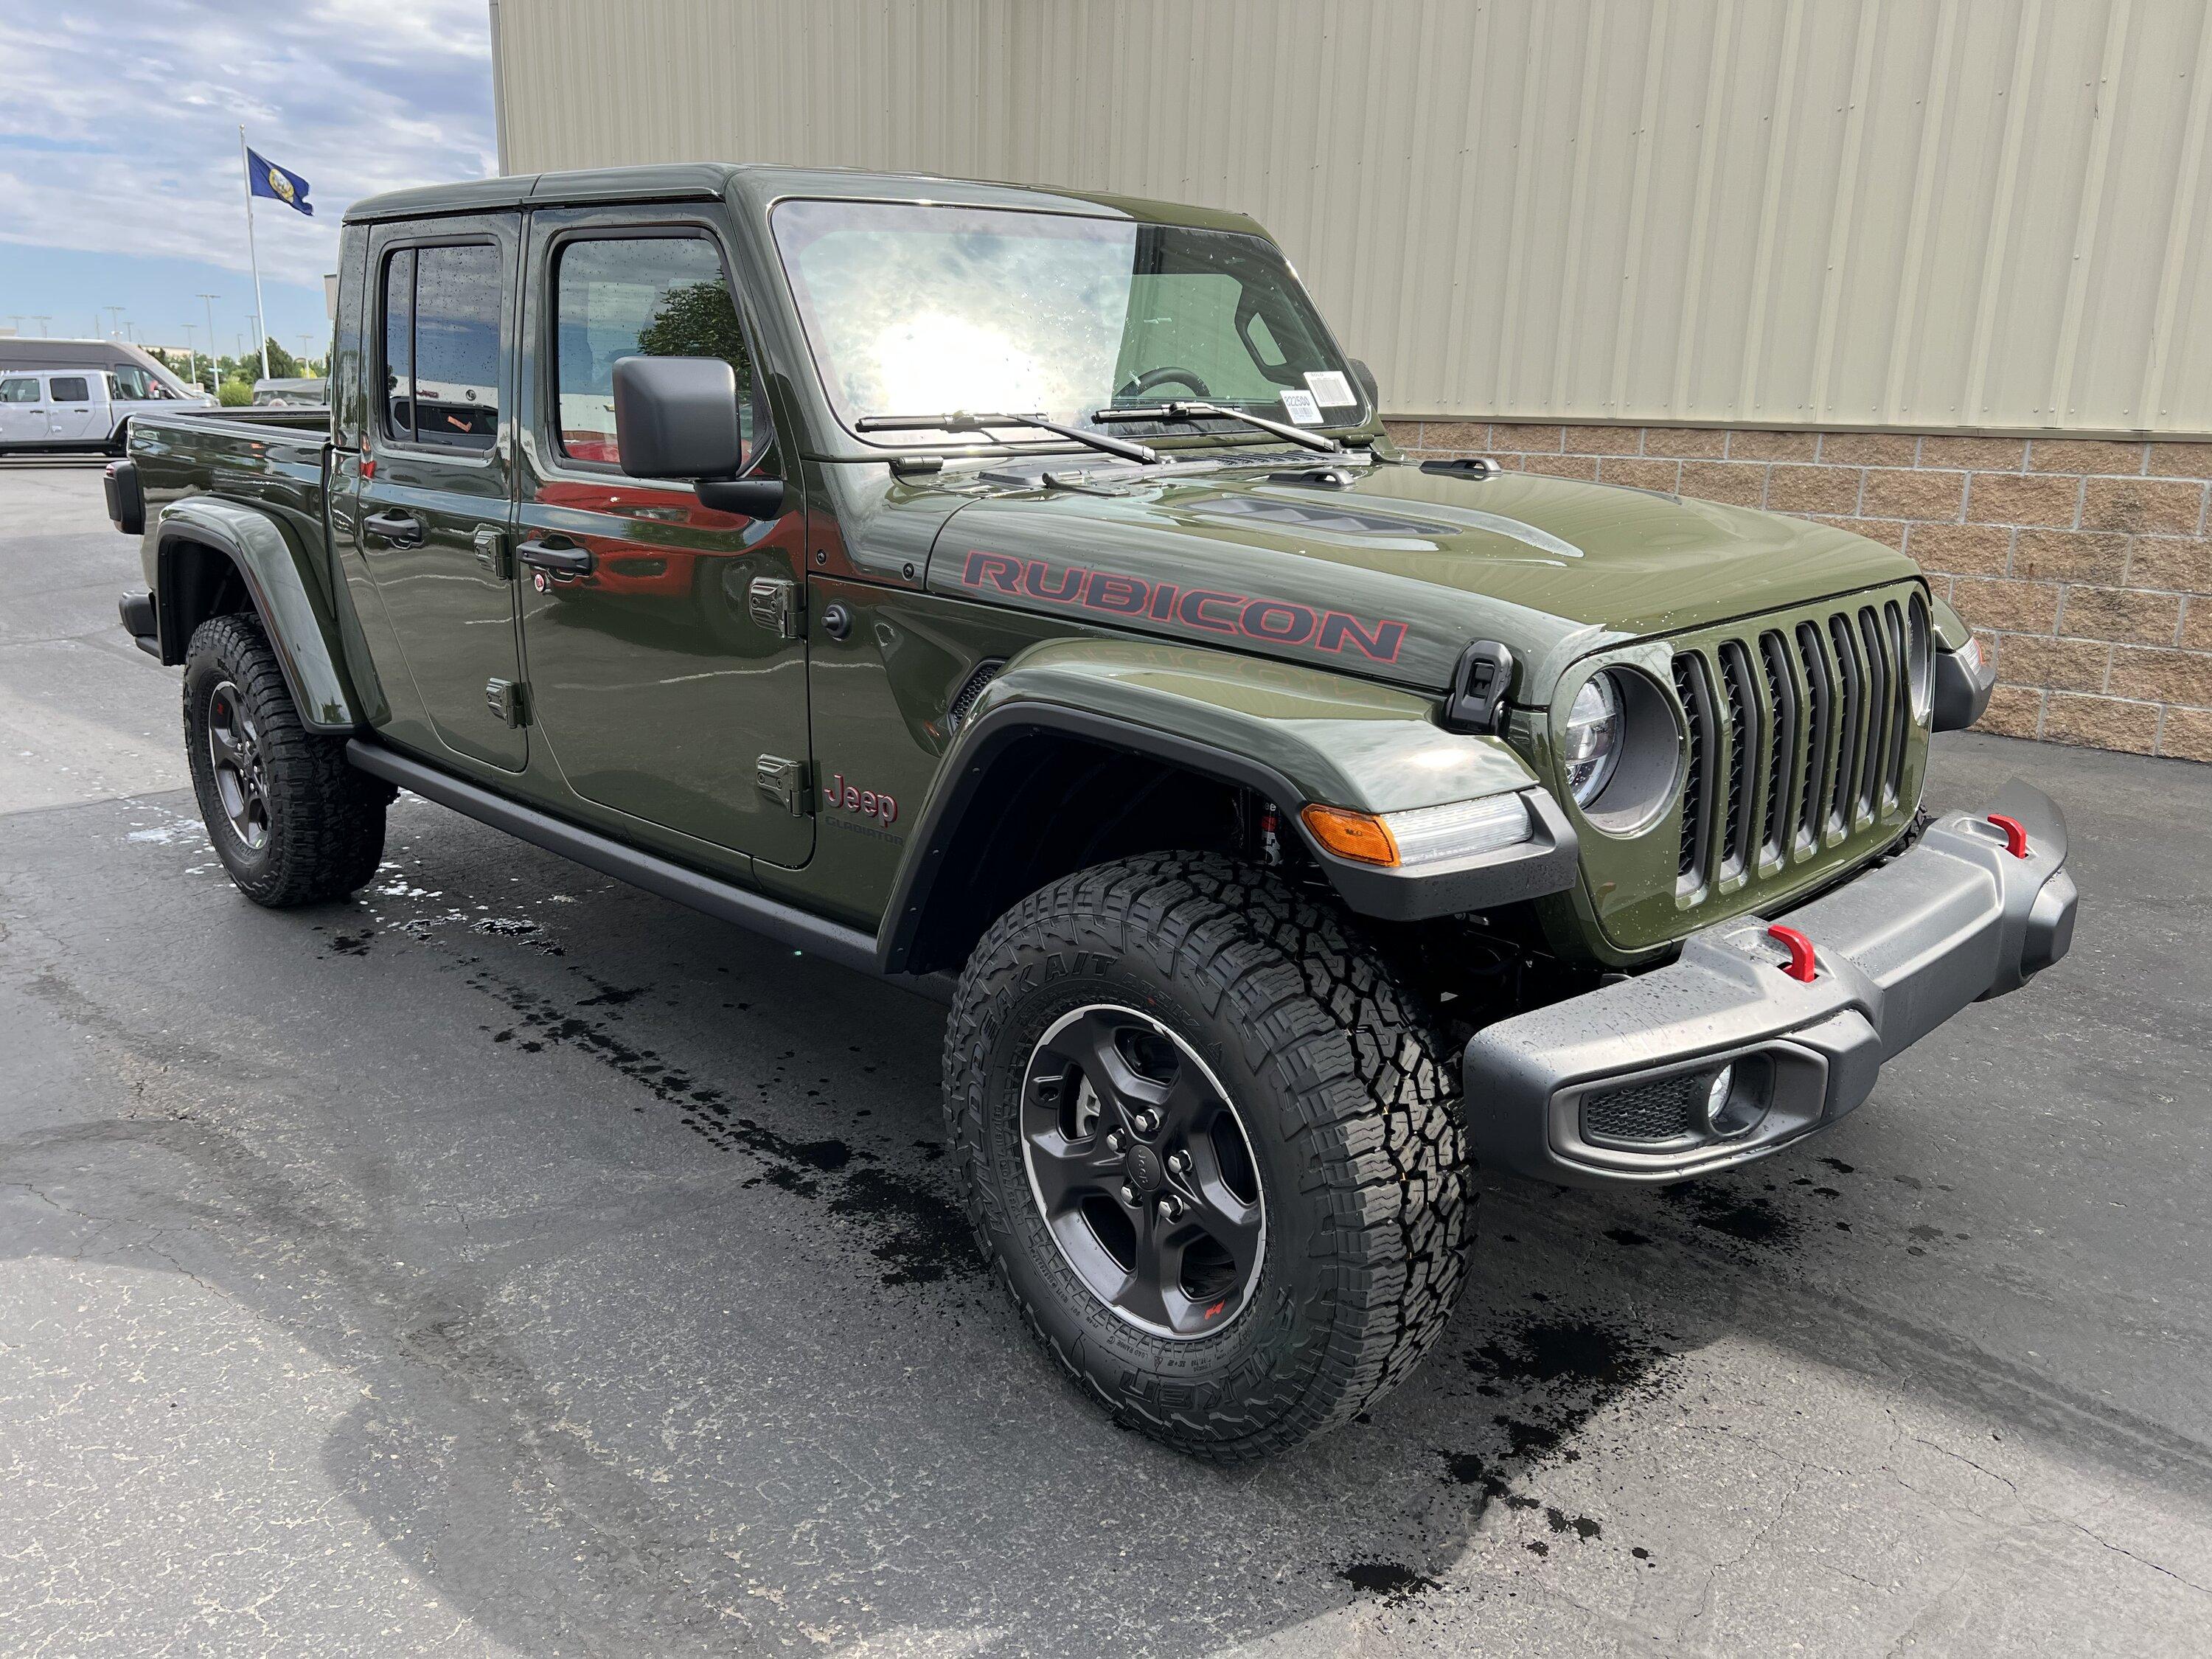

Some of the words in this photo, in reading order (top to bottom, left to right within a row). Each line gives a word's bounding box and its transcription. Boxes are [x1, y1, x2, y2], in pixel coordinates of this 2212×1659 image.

[961, 550, 1409, 664] RUBICON
[824, 773, 898, 829] Jeep
[825, 815, 904, 847] GLADIATOR
[1138, 1150, 1149, 1183] Jeep
